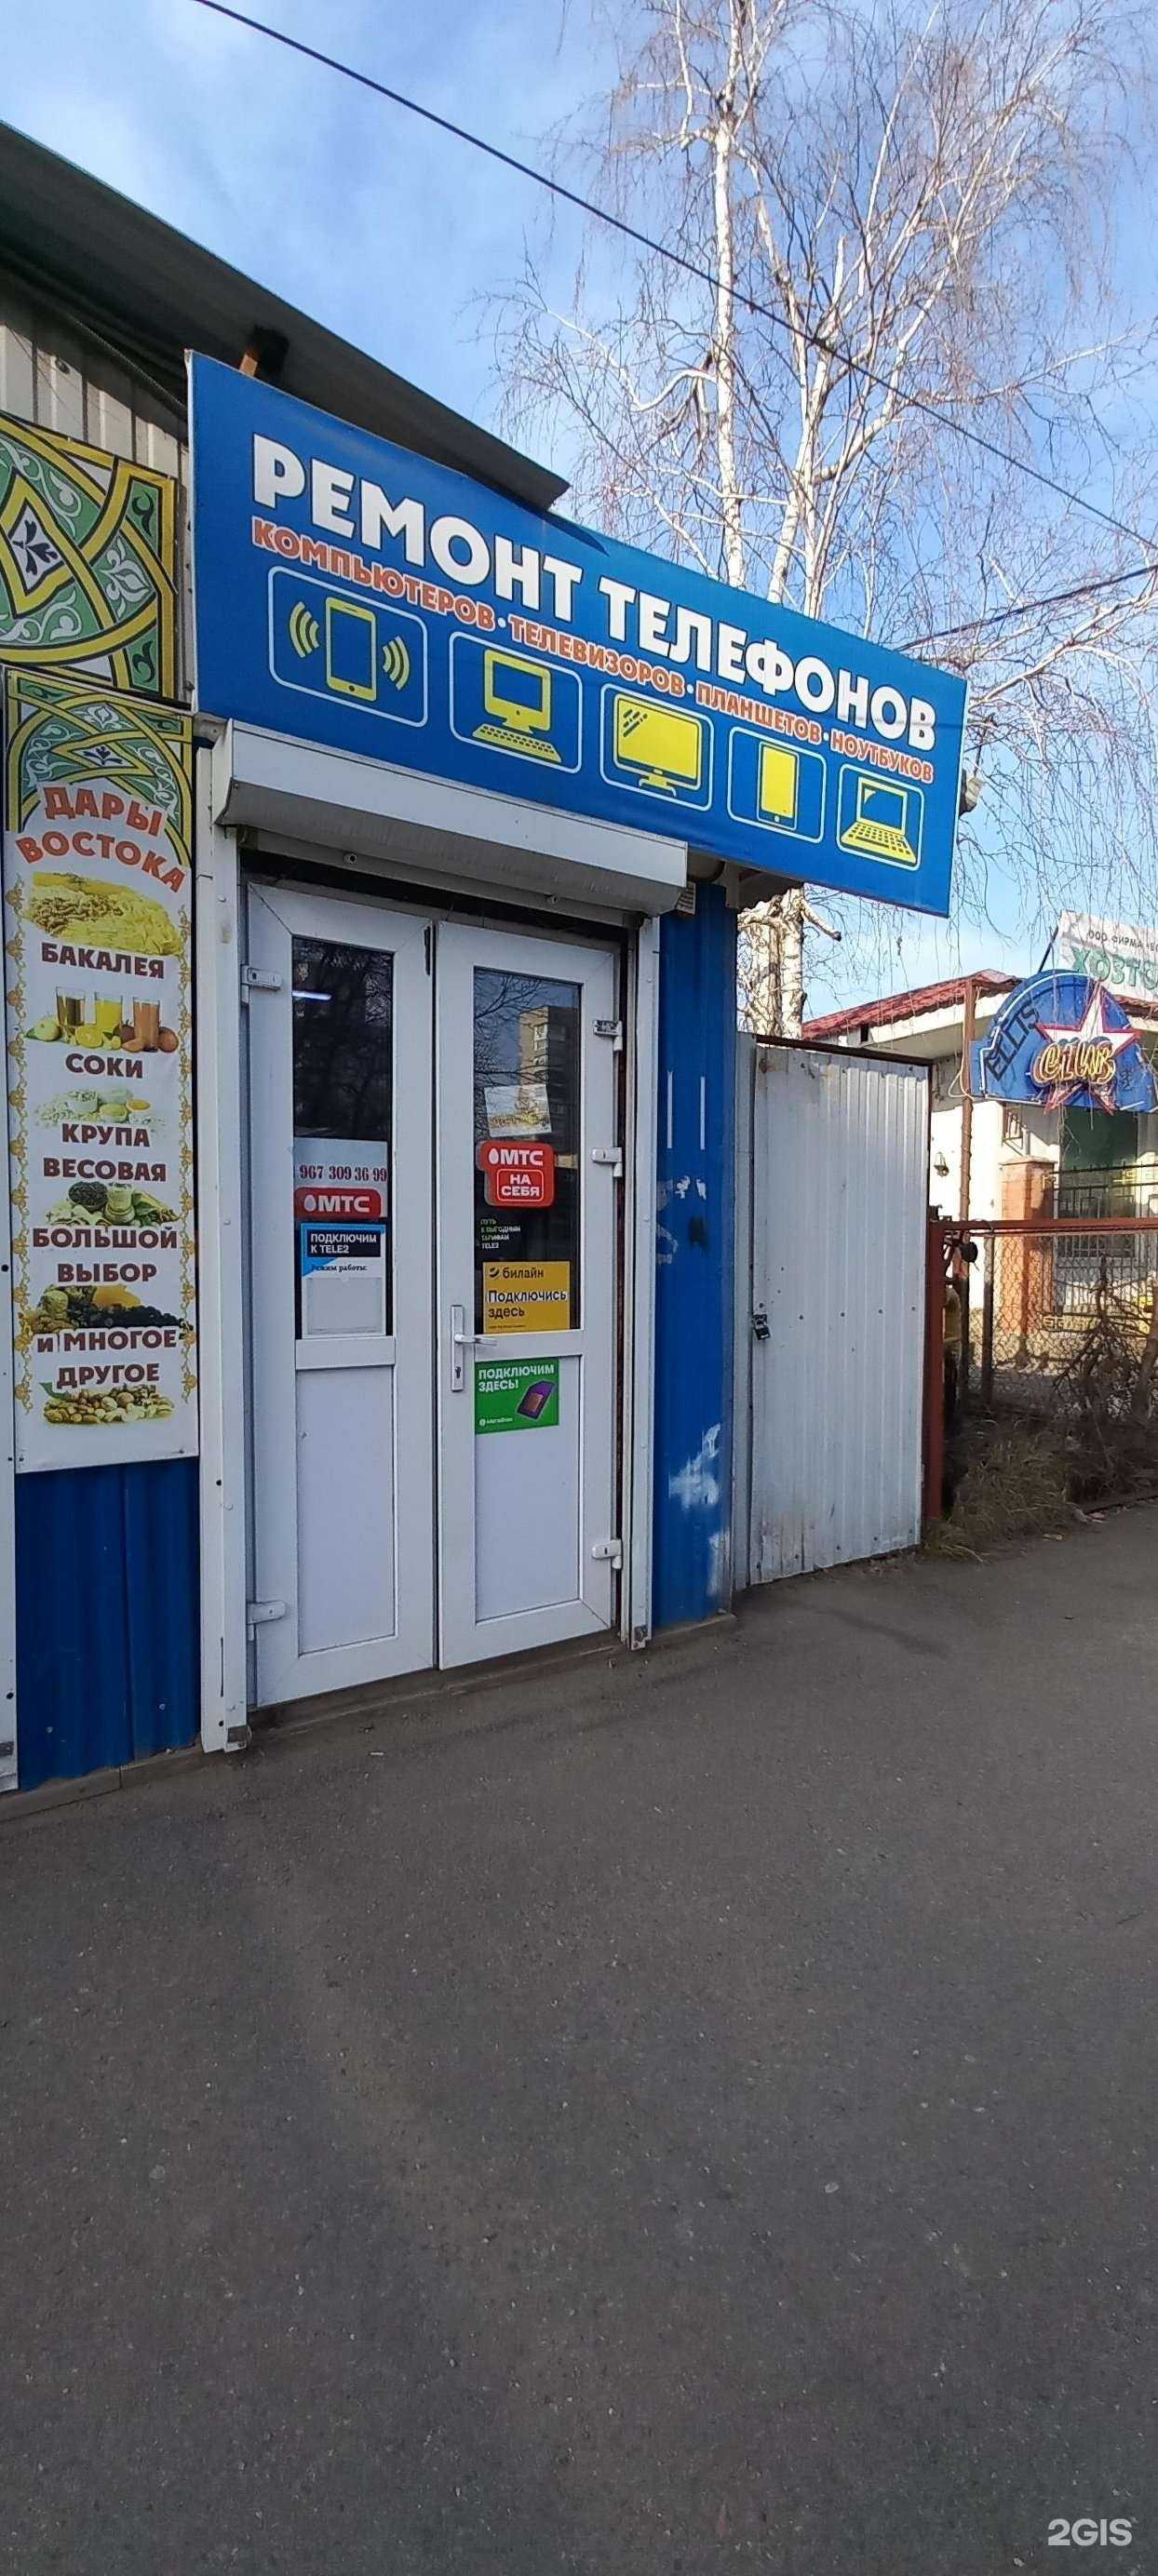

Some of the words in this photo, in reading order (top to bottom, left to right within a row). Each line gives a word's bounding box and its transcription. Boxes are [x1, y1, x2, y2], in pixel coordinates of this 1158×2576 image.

[252, 433, 583, 622] РЕМОНТ
[598, 576, 936, 752] ТЕЛЕФОНОВ
[251, 517, 496, 631] КОМПЬЮТЕРОВ
[509, 615, 685, 696] ТЕЛЕВИЗОРОВ
[695, 682, 823, 744] ПЛАНШЕТОВ
[829, 728, 935, 784] НОУТБУКОВ
[43, 786, 163, 838] ДАРЫ
[16, 831, 186, 893] ВОСТОКА
[41, 942, 165, 979] БАКАЛЕЯ
[65, 1053, 143, 1079] СОКИ
[61, 1123, 150, 1147] КРУПА
[500, 1148, 544, 1166] МТС
[43, 1157, 167, 1182] ВЕСОВАЯ
[300, 1165, 323, 1179] 967
[329, 1166, 352, 1180] 309
[355, 1167, 370, 1181] 36
[372, 1168, 387, 1182] 99
[510, 1174, 532, 1185] НА
[501, 1186, 540, 1197] СЕБЯ
[317, 1195, 370, 1213] МТС
[33, 1227, 178, 1249] БОЛЬШОЙ
[311, 1233, 377, 1243] ПОДКЛЮЧИМ
[311, 1245, 317, 1254] К
[319, 1245, 349, 1254] TELE2
[57, 1263, 157, 1282] ВЫБОР
[503, 1268, 545, 1279] билайн
[488, 1290, 567, 1304] Подключись
[488, 1306, 525, 1320] здесь
[63, 1329, 177, 1350] МНОГОЕ
[56, 1363, 160, 1390] ДРУГОЕ
[478, 1364, 555, 1381] ПОДКЛЮЧИМ
[478, 1379, 519, 1394] ЗДЕСЬ!
